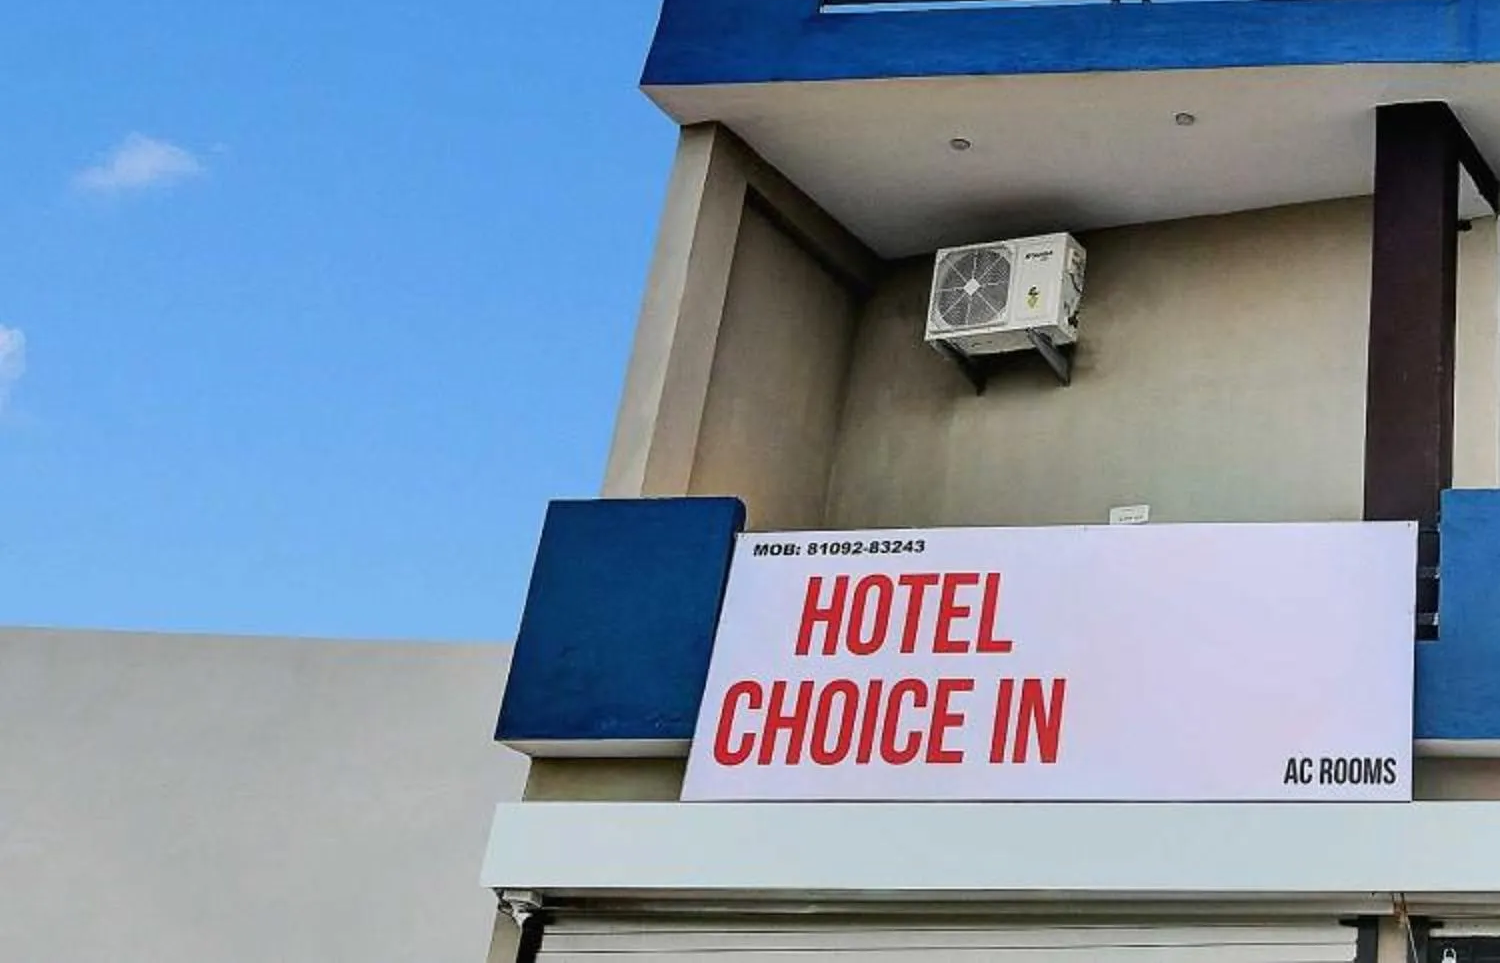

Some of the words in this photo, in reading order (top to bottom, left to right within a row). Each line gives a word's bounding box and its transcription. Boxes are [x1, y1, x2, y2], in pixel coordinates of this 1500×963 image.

[753, 542, 801, 557] MOB:
[806, 539, 926, 556] 81092-83243
[795, 572, 1013, 656] HOTEL
[713, 677, 974, 766] CHOICE
[989, 677, 1066, 764] IN
[1283, 756, 1313, 785] AC
[1319, 756, 1397, 785] ROOMS
